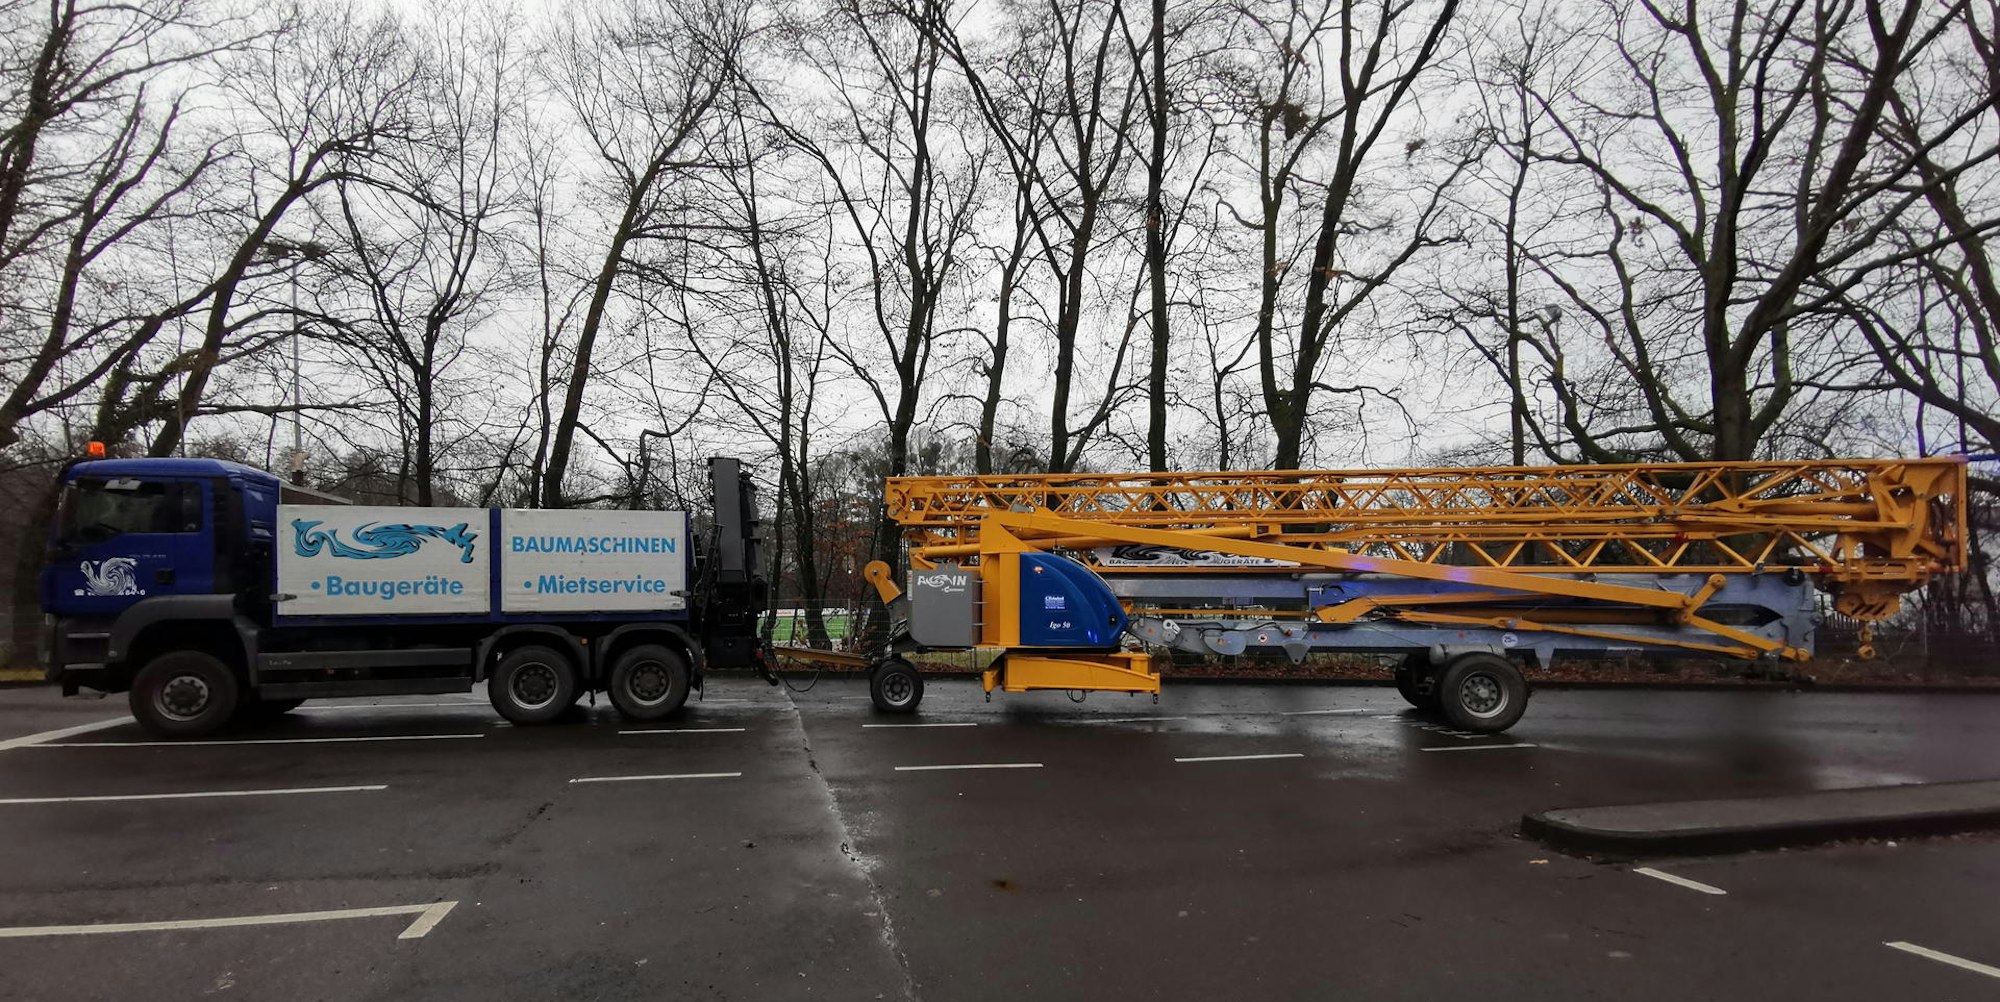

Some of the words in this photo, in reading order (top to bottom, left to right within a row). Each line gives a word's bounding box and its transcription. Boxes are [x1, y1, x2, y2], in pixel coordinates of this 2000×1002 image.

[512, 537, 675, 553] BAUMASCHINEN
[327, 576, 463, 600] Baugeräte
[538, 576, 666, 594] Mietservice
